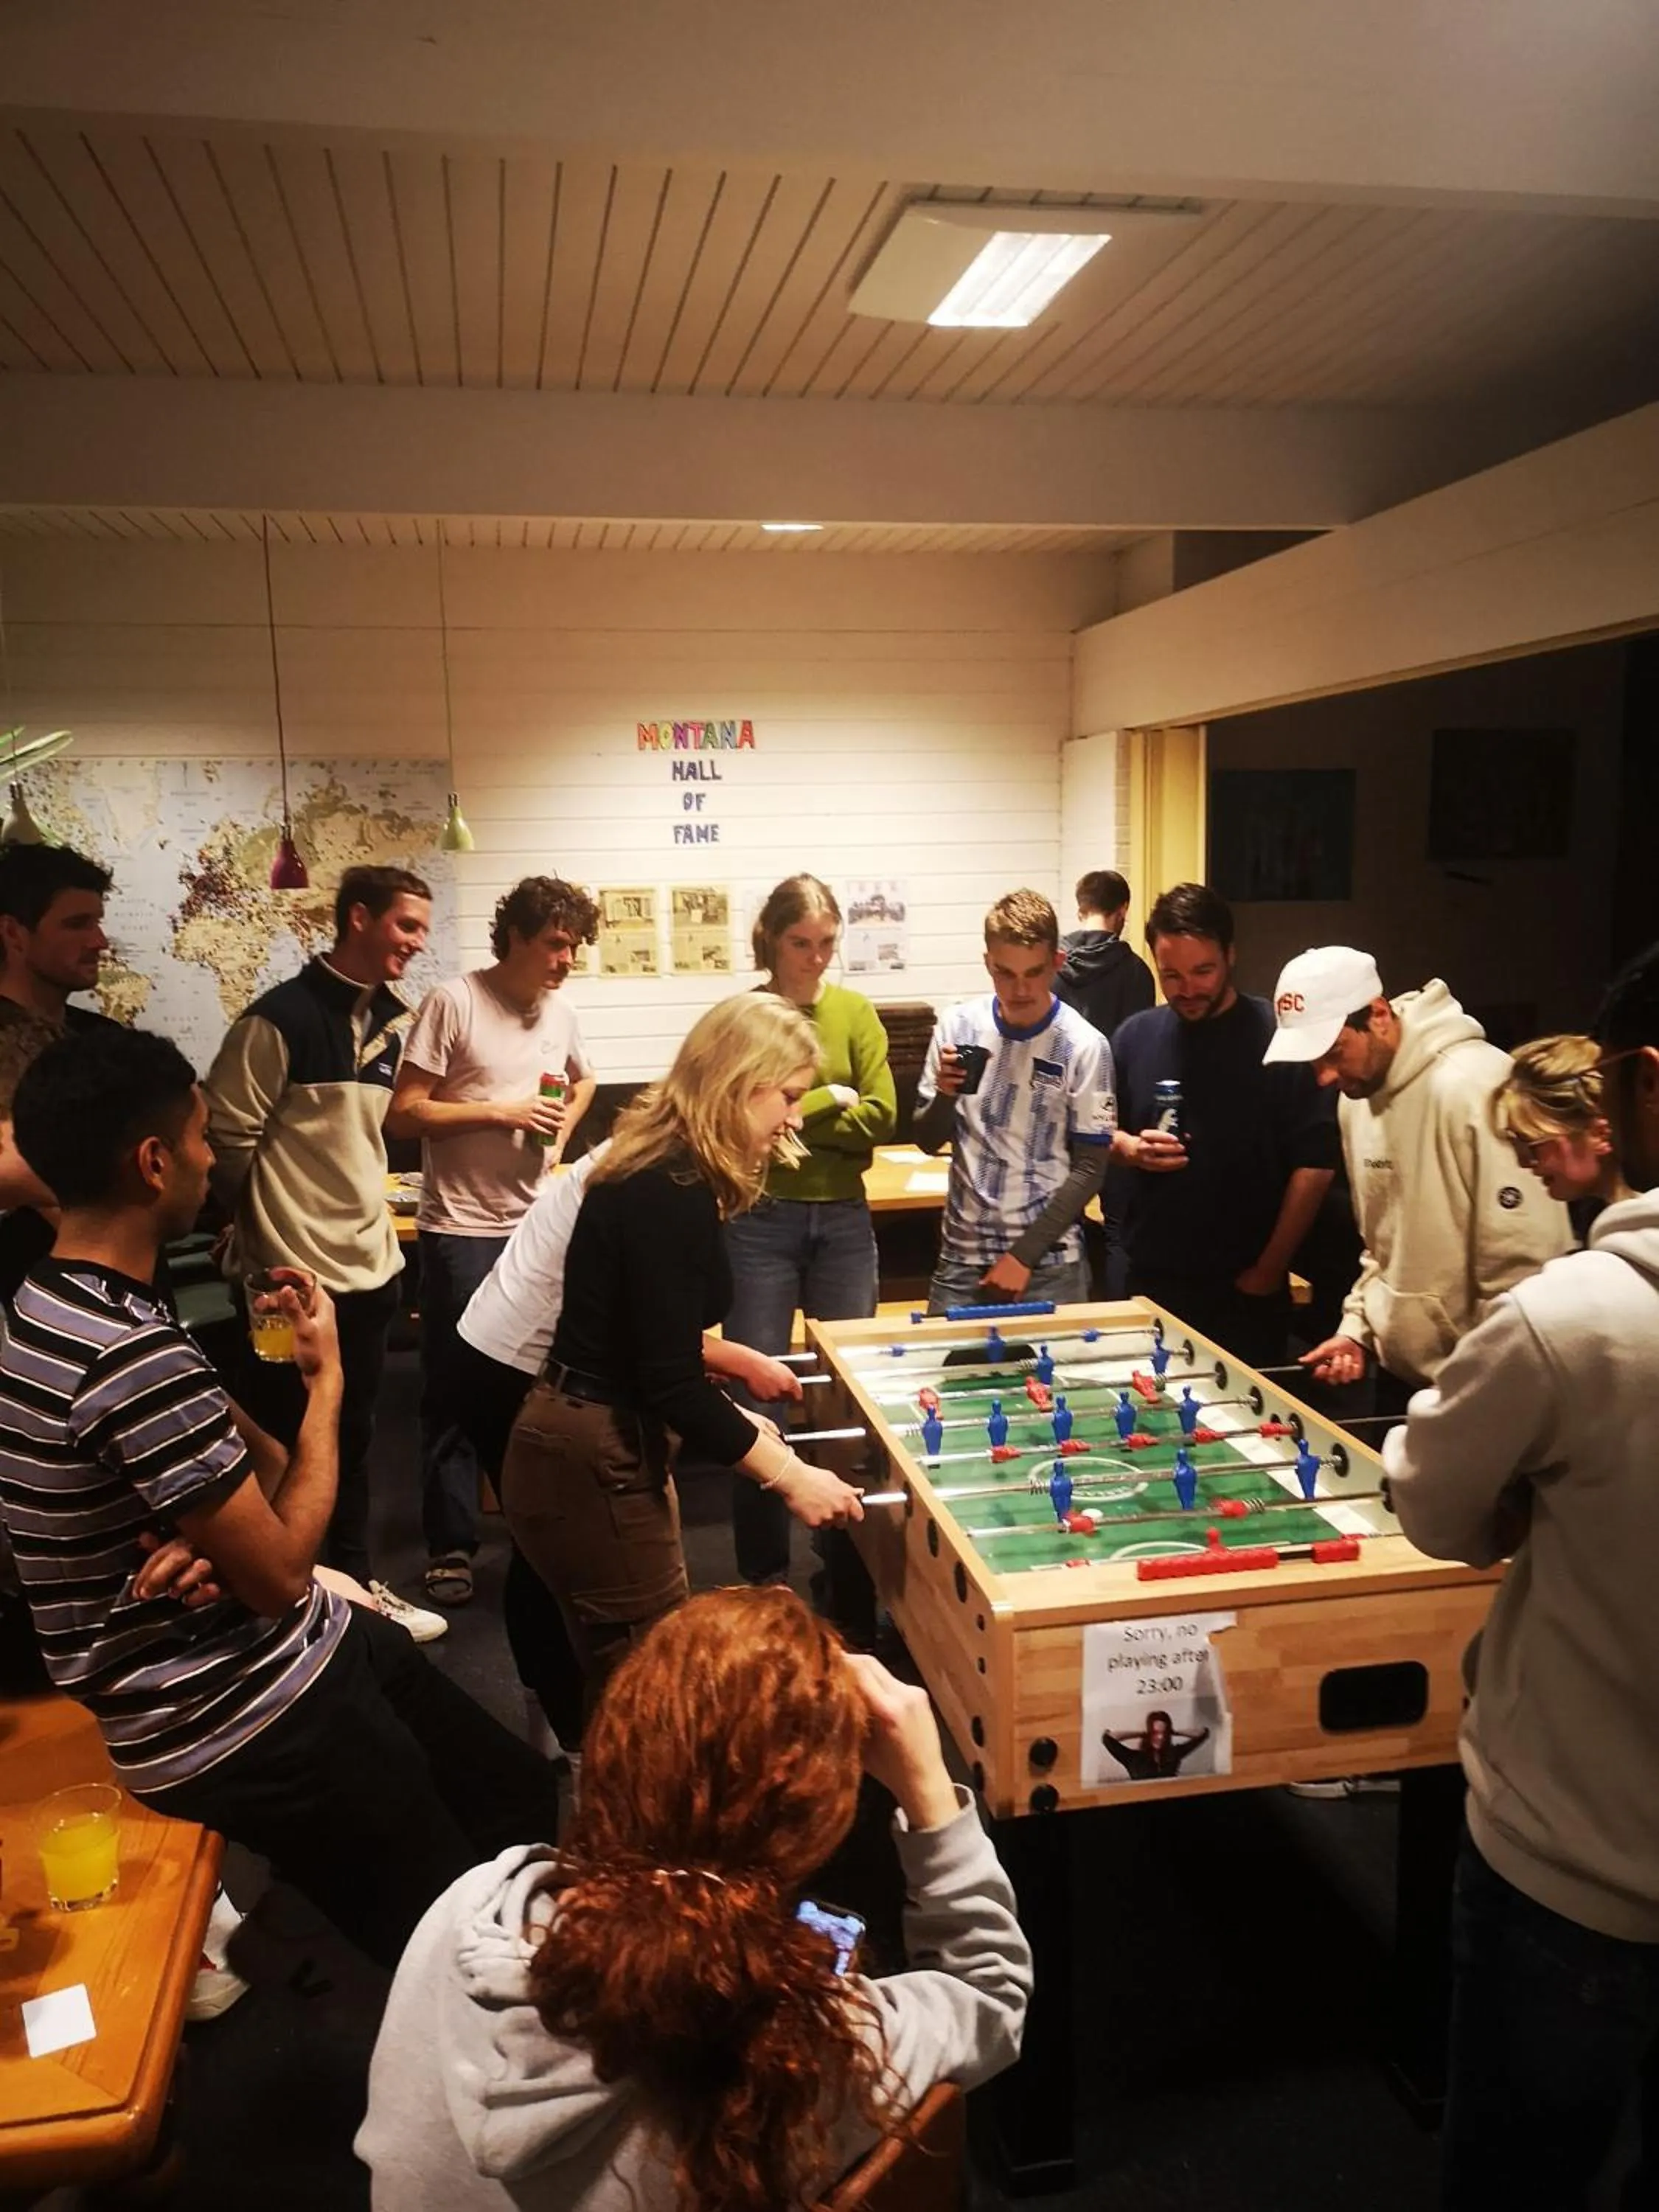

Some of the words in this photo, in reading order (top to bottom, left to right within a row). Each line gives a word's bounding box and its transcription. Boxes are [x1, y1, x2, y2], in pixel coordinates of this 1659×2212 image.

[637, 720, 754, 751] MONTANA
[672, 760, 722, 780] HALL
[684, 792, 706, 811] OF
[673, 824, 720, 844] FAME
[1123, 1626, 1172, 1643] Sorry,
[1178, 1624, 1197, 1638] no
[1108, 1652, 1168, 1672] playing
[1172, 1648, 1209, 1664] after
[1136, 1676, 1183, 1694] 23:00
